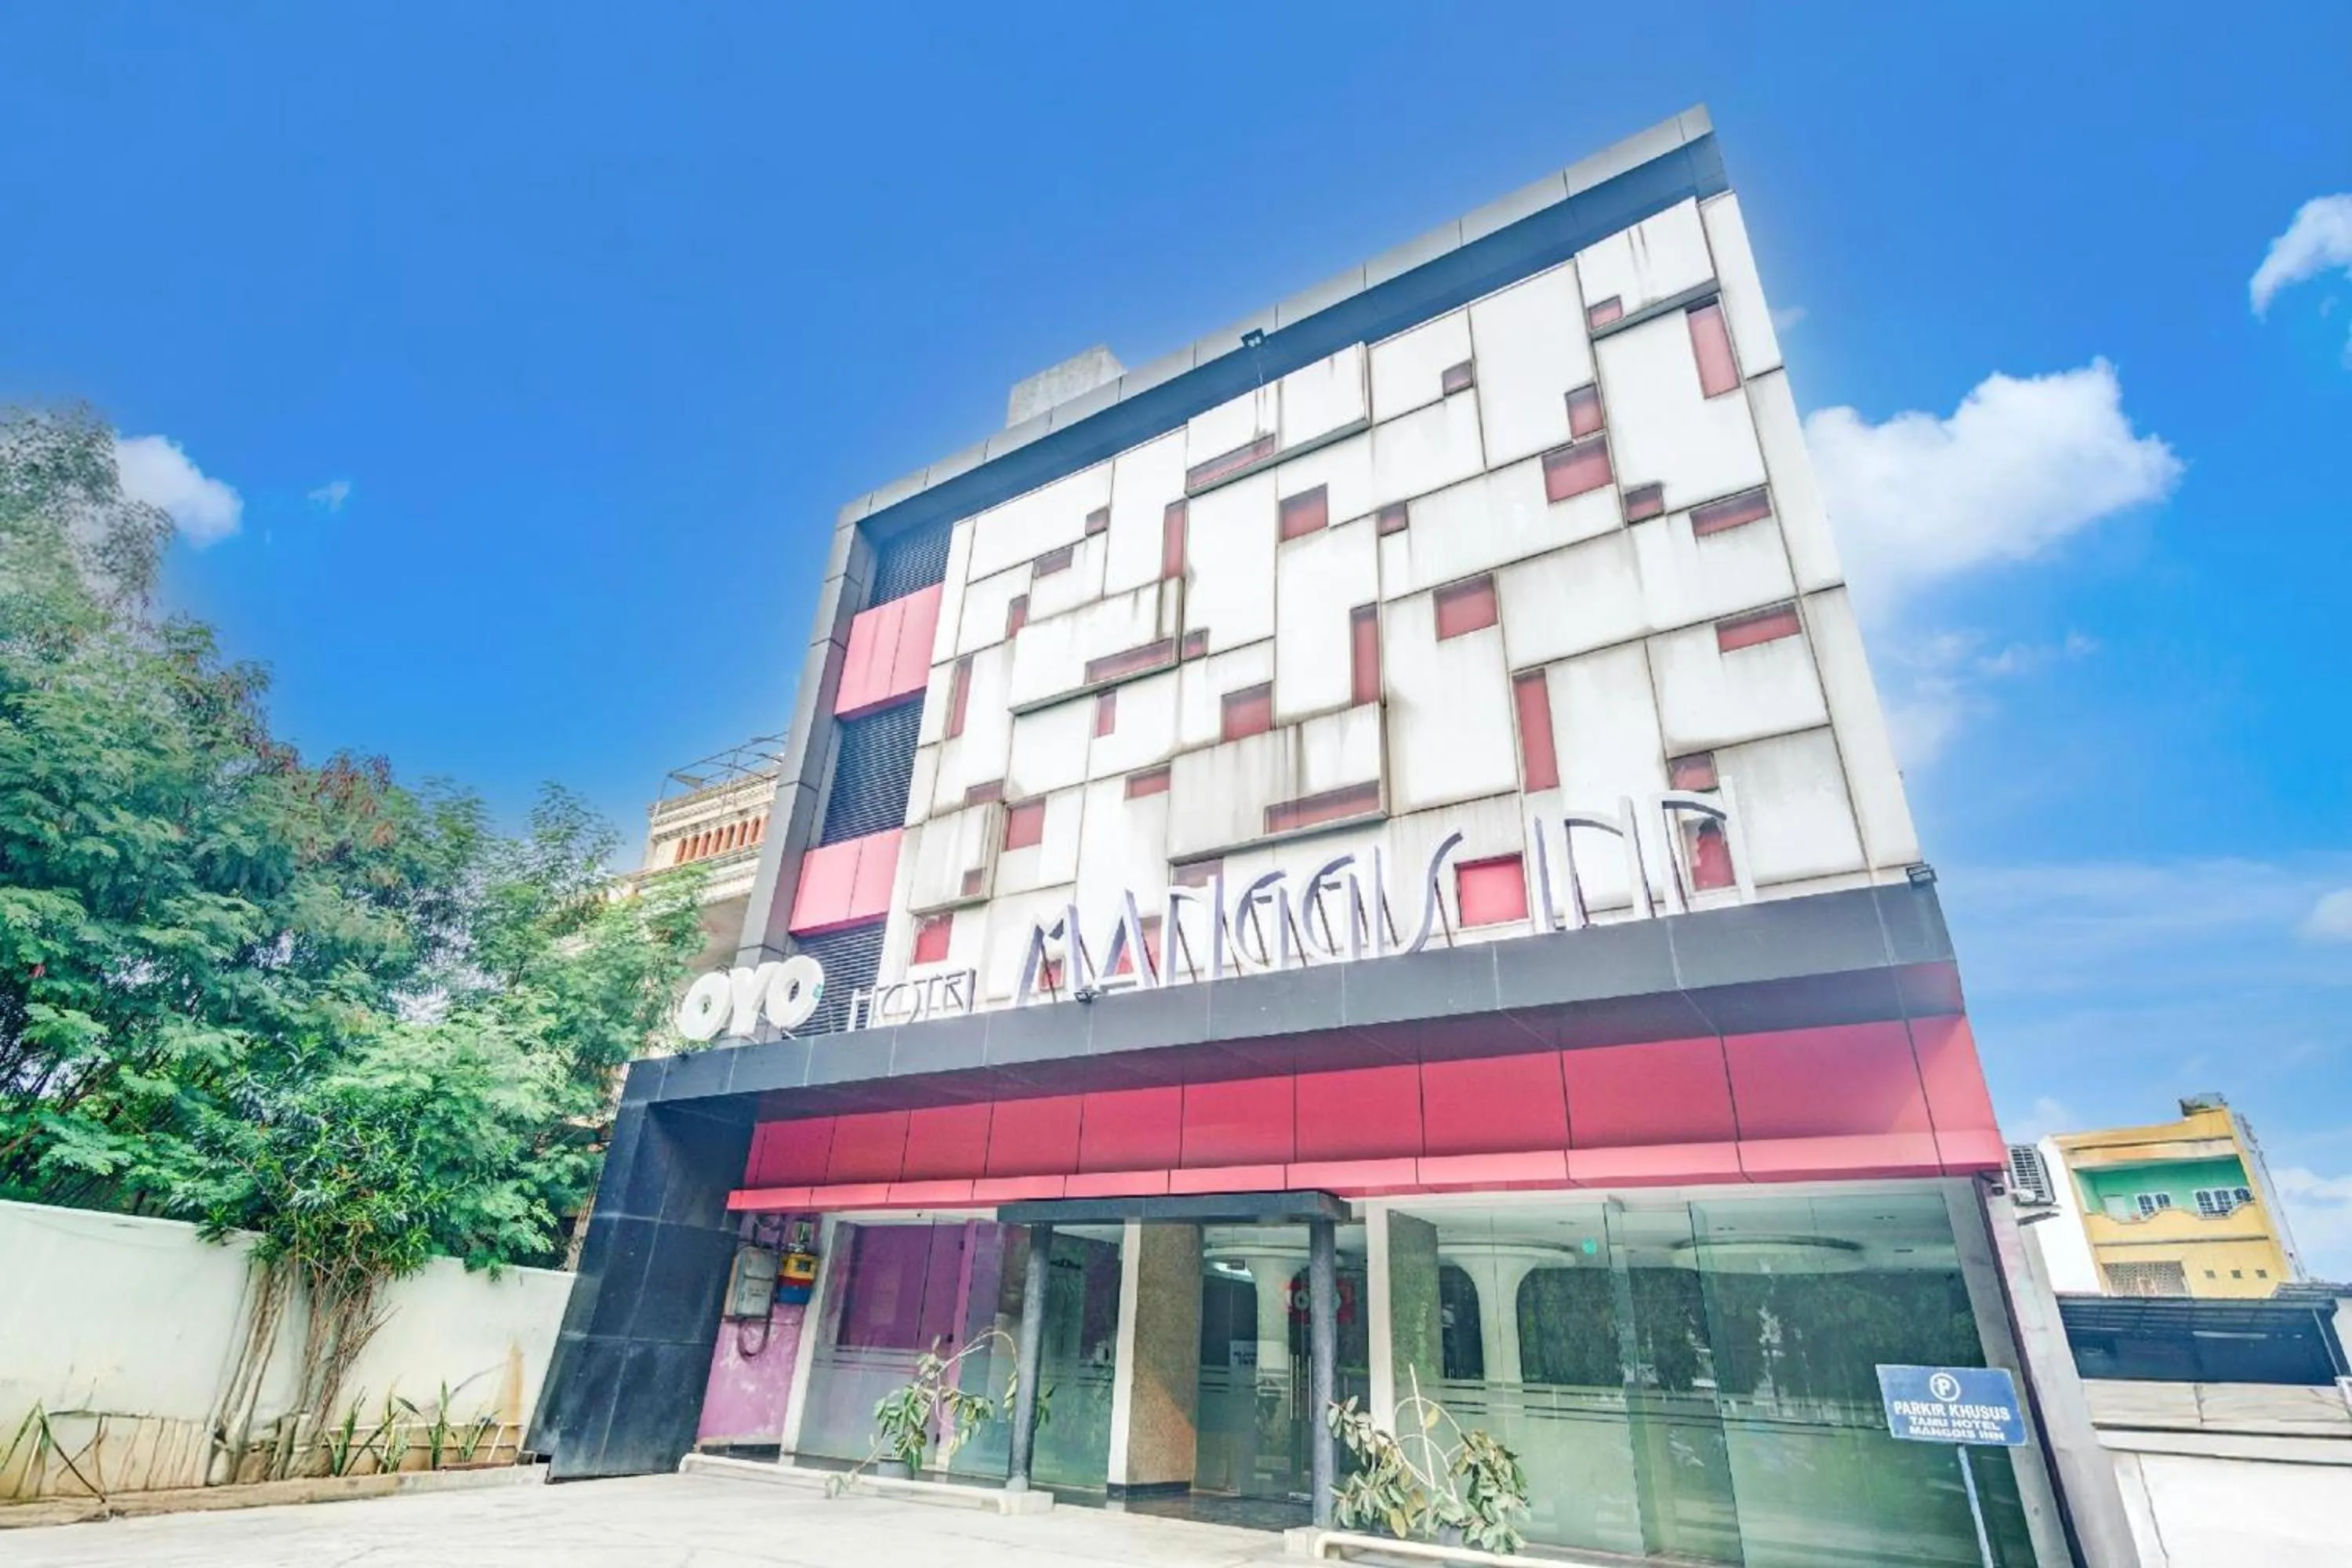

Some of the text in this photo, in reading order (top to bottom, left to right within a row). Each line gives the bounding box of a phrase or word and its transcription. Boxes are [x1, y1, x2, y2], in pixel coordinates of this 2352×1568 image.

[1533, 775, 1758, 935] INN
[679, 955, 825, 1042] OYO
[1893, 1400, 2011, 1421] PARKIR KHUSUS
[1911, 1416, 2001, 1431] TAMU HOTEL
[1978, 1431, 2005, 1441] INN
